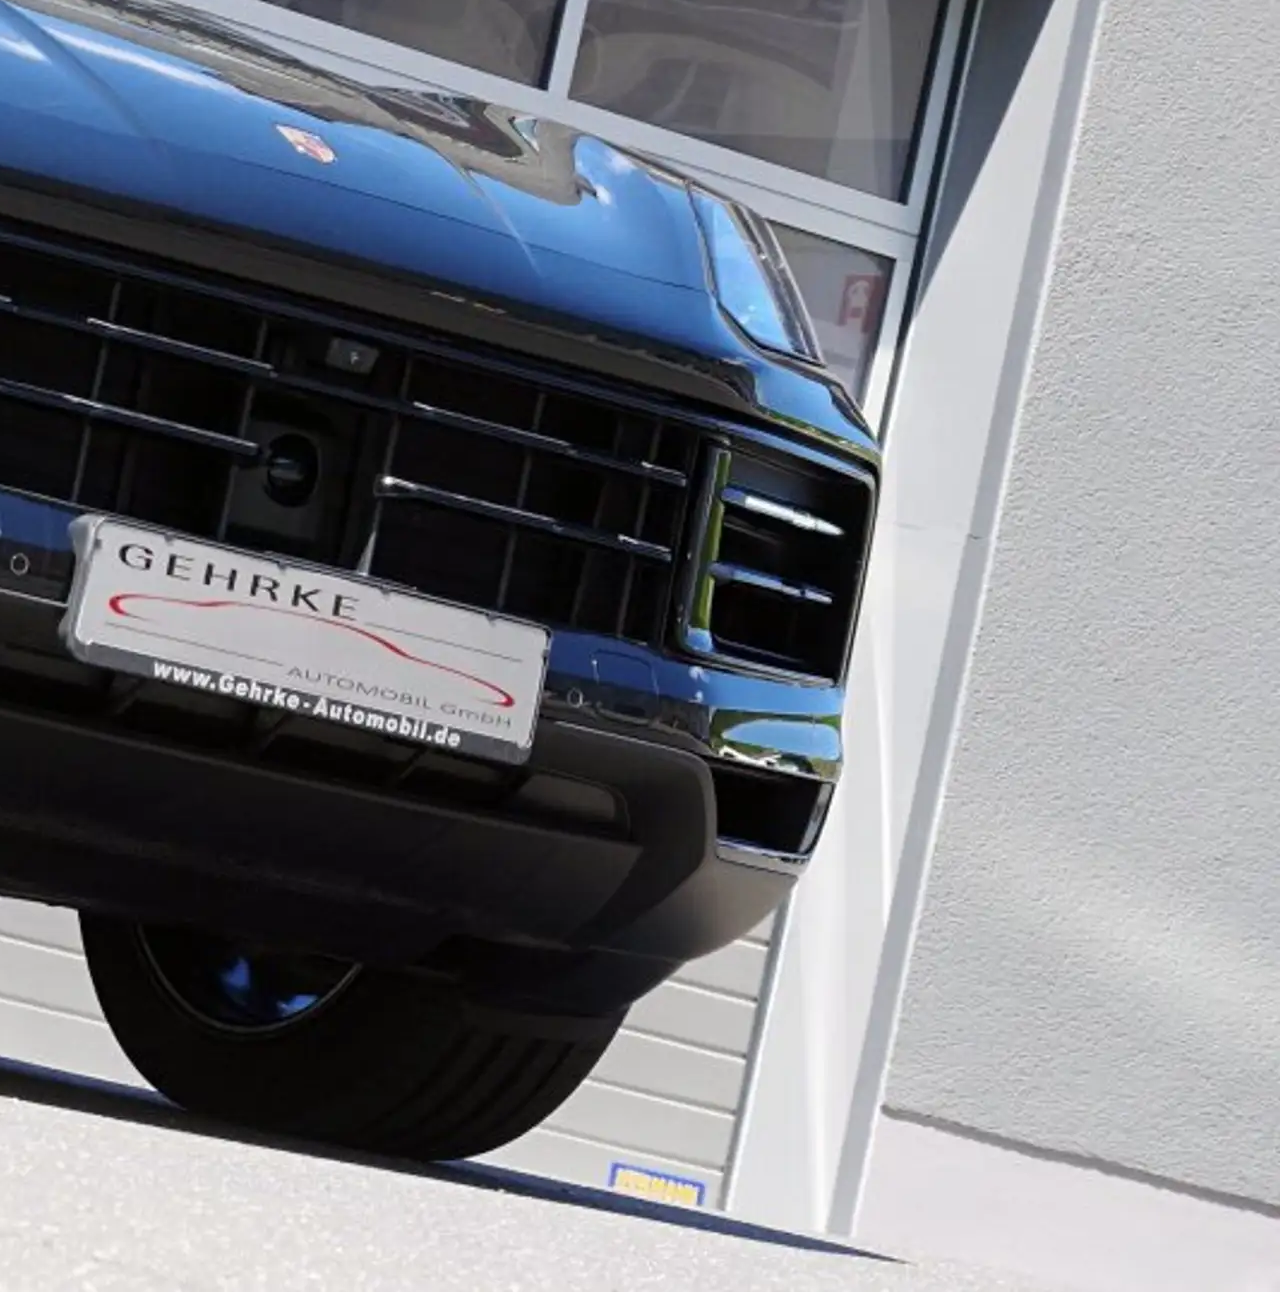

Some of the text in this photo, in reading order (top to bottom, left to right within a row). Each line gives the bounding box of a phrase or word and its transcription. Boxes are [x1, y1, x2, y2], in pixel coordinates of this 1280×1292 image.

[118, 543, 359, 622] GEHRKE
[287, 666, 512, 729] AUTOMOBIL GmbH
